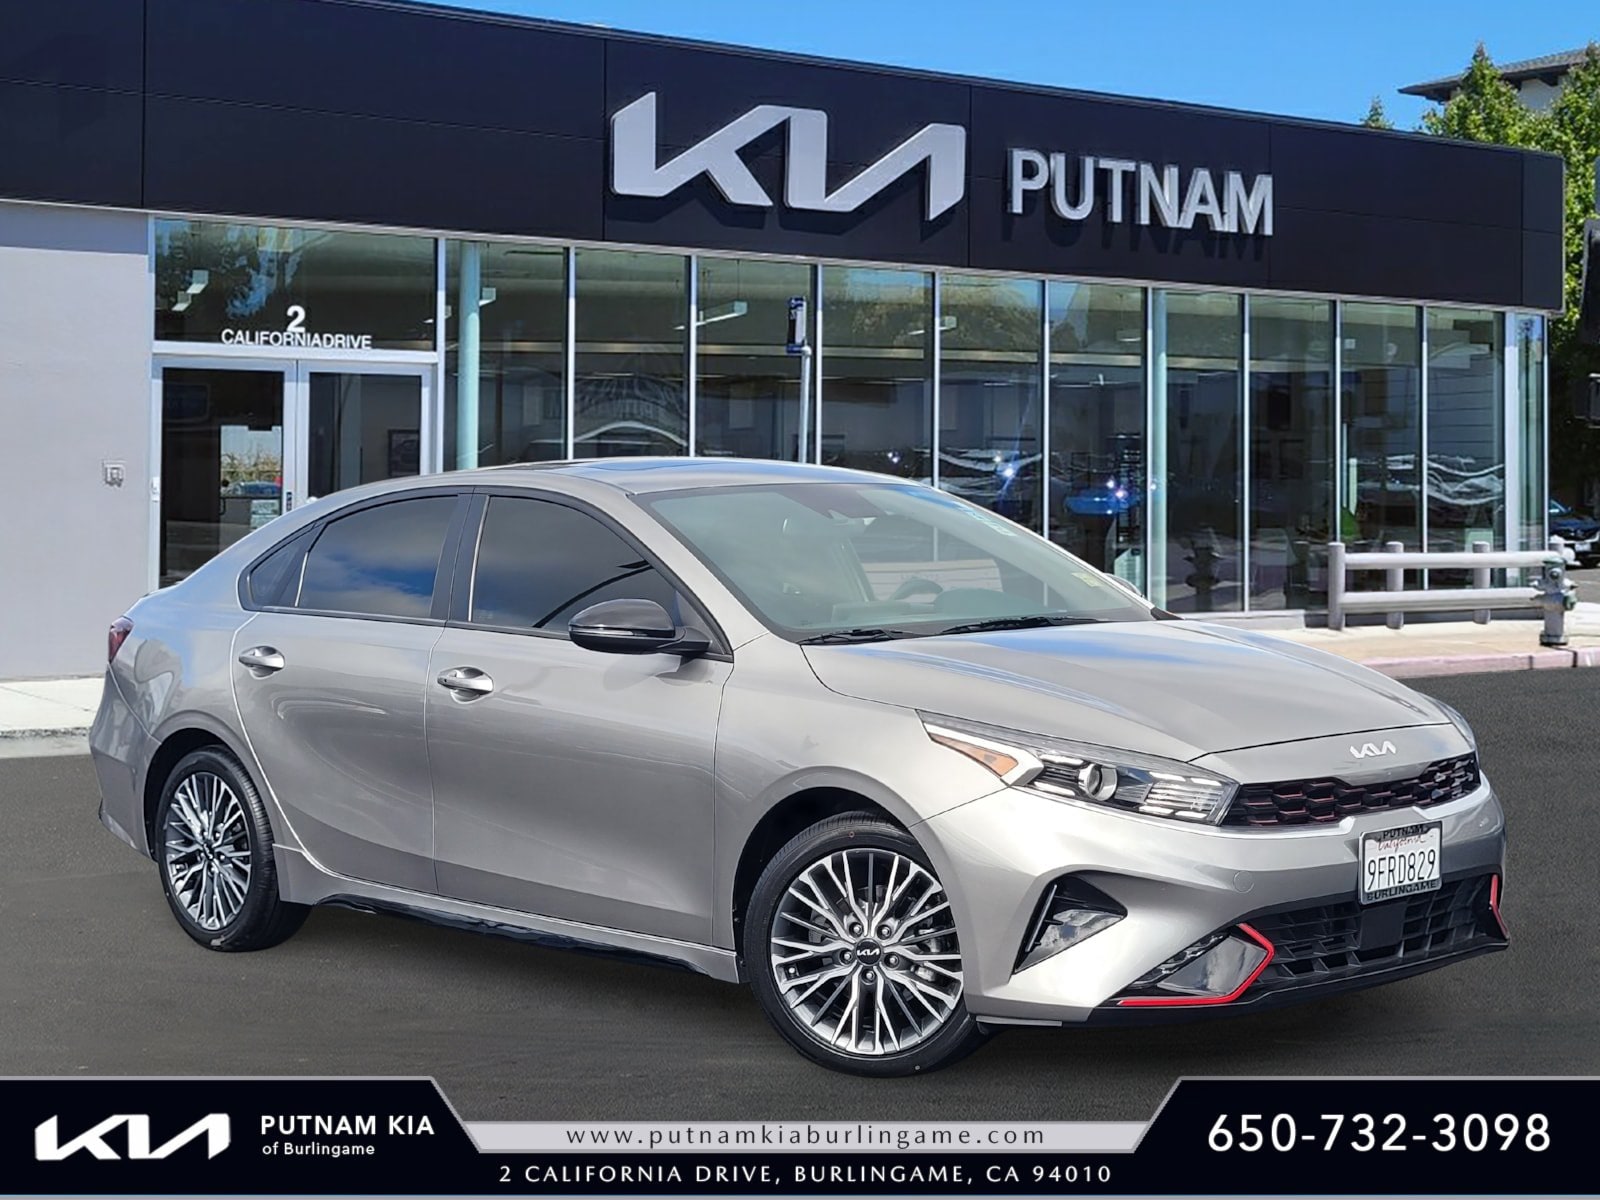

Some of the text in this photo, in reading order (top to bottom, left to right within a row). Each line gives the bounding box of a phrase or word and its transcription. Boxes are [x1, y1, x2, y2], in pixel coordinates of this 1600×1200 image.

[610, 91, 967, 221] KIA
[1007, 146, 1274, 236] PUTNAM
[286, 304, 306, 333] 2
[1349, 740, 1397, 759] KIA
[1382, 824, 1426, 840] PUTNAM
[1367, 848, 1437, 891] 9FRD829
[1366, 879, 1438, 901] BURLINGAME
